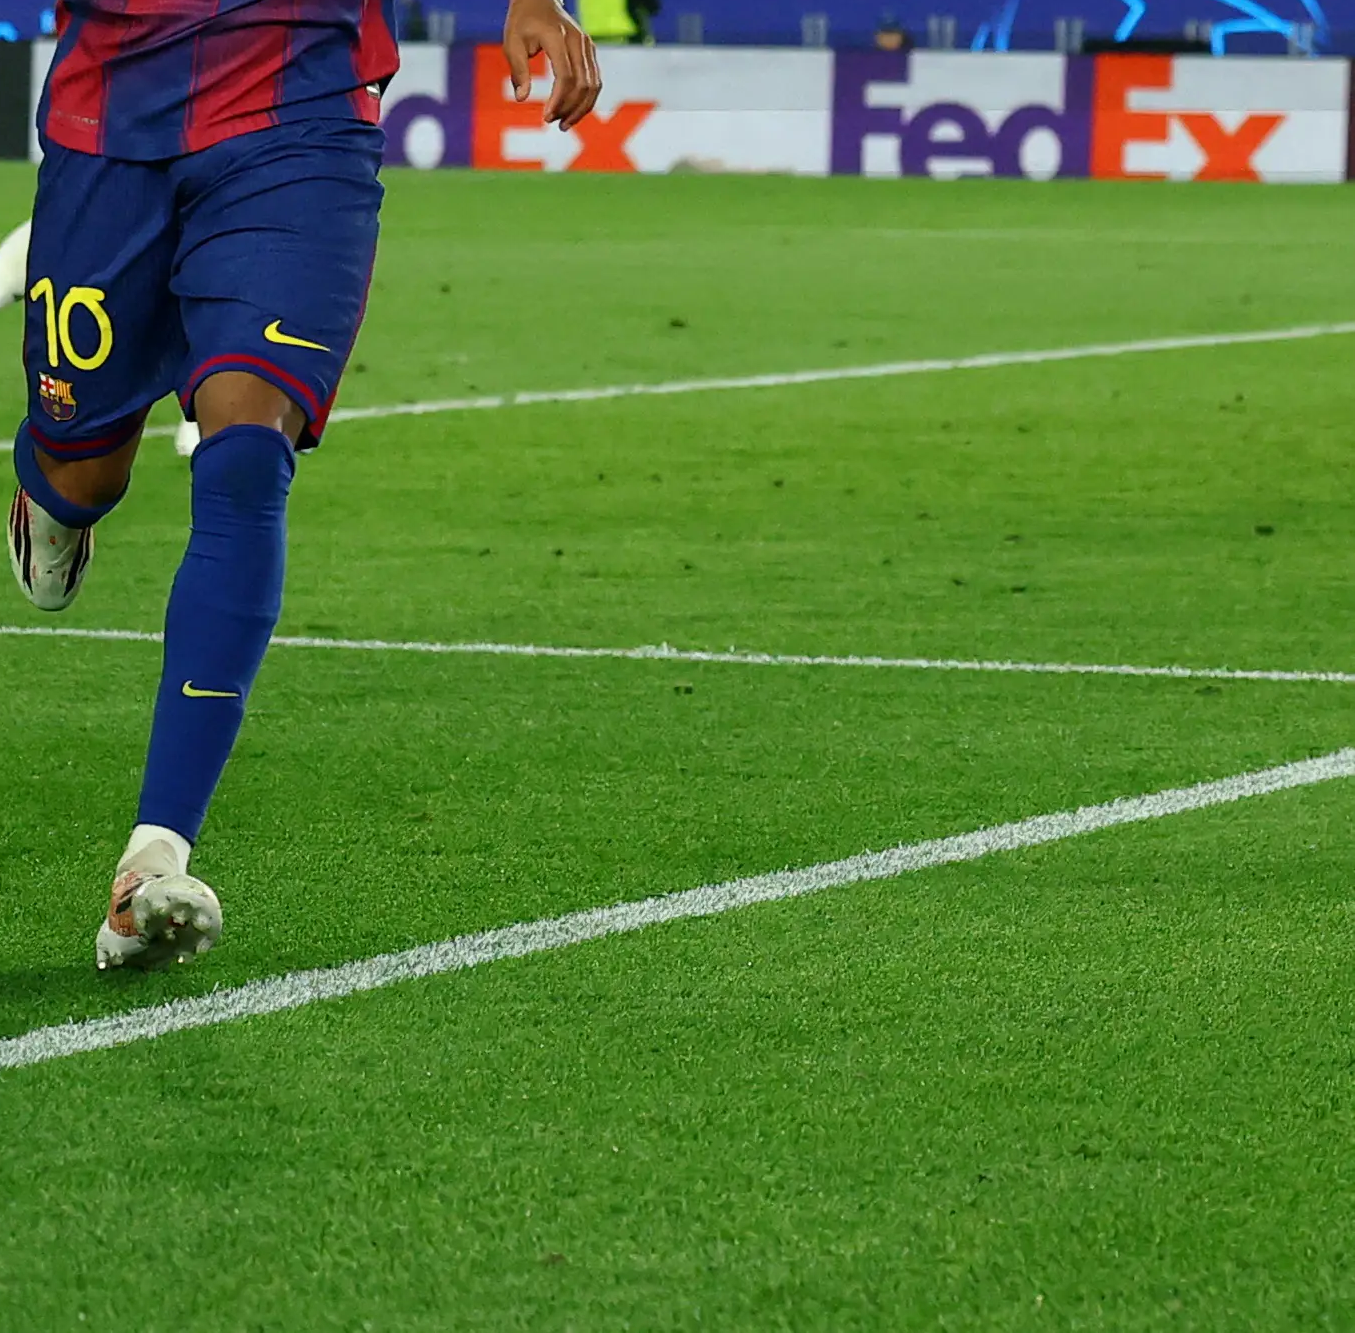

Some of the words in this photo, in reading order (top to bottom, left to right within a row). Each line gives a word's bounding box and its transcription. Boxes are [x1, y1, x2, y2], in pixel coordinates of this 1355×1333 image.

[381, 40, 659, 174] dEx
[831, 49, 1288, 182] FedEx
[29, 277, 114, 371] 10
